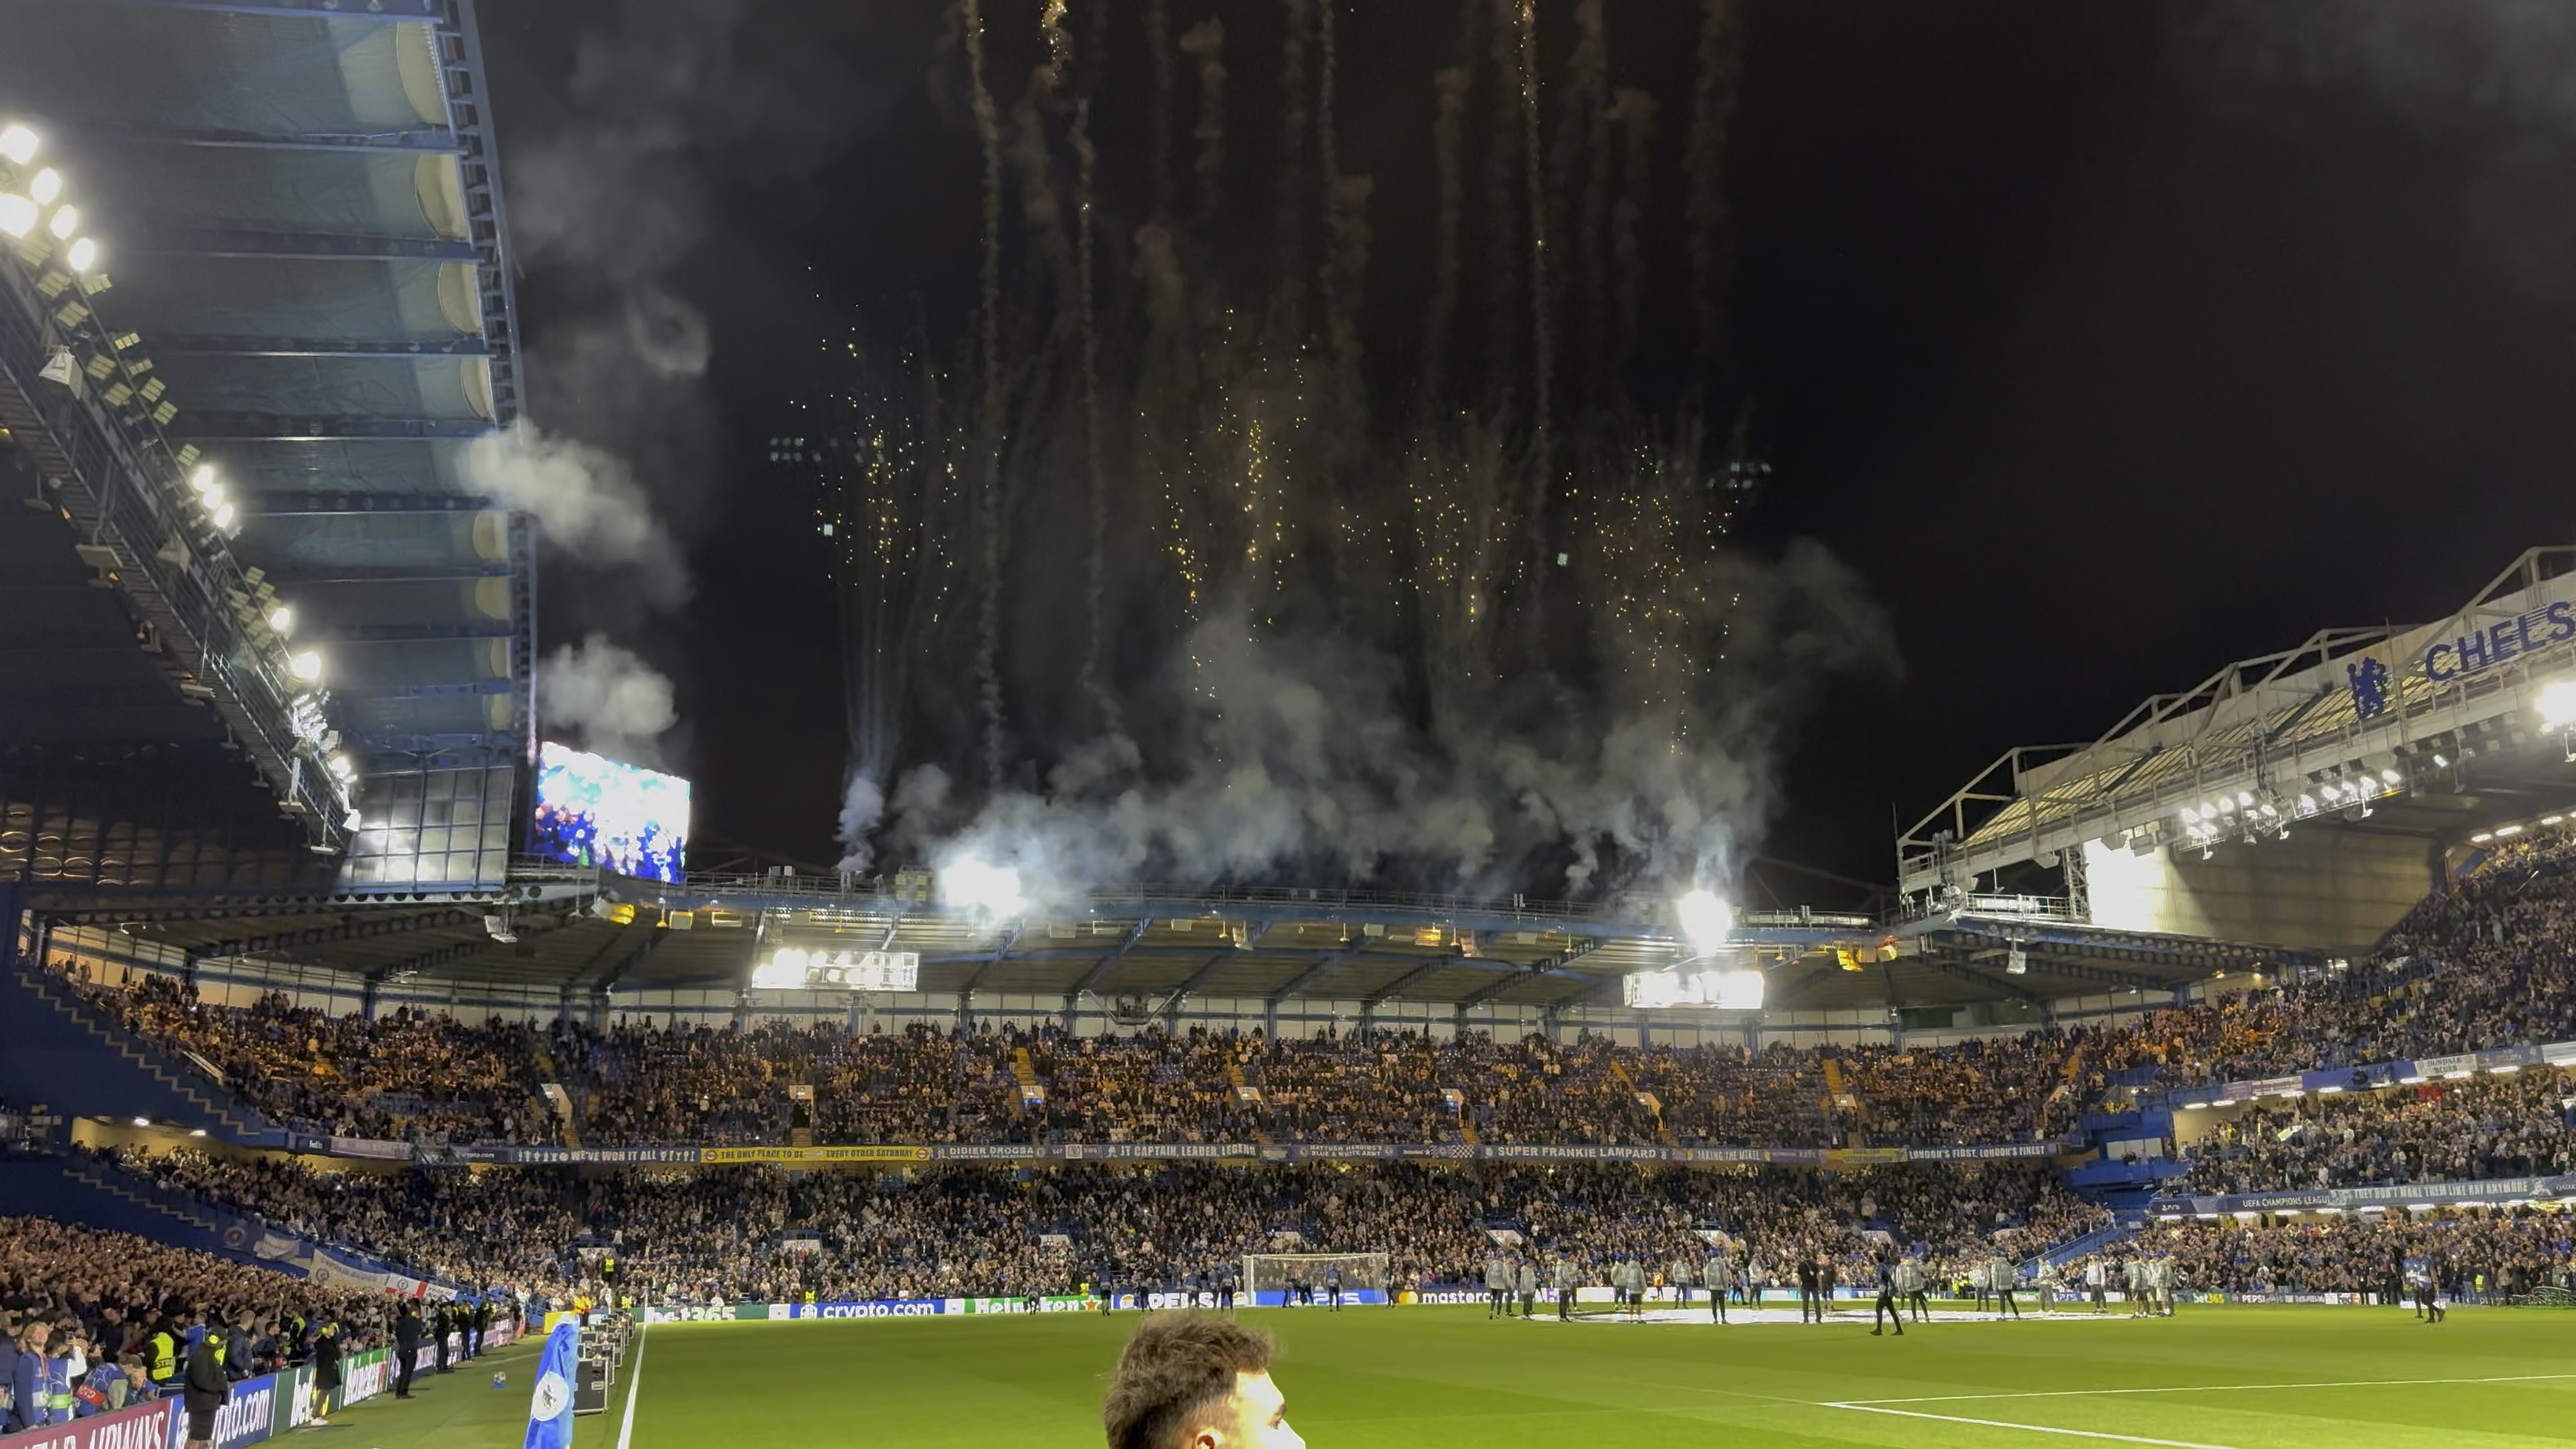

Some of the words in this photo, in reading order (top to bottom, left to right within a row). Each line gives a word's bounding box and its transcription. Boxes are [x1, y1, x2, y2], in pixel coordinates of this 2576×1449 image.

[2425, 601, 2576, 682] CHELS
[570, 1150, 600, 1161] WE'VE
[602, 1150, 625, 1161] WON
[627, 1150, 638, 1161] IT
[640, 1150, 657, 1161] ALL
[721, 1151, 735, 1159] THE
[737, 1150, 755, 1159] ONLY
[757, 1149, 780, 1158] PLACE
[782, 1150, 792, 1158] TO
[794, 1150, 804, 1159] BE
[826, 1149, 848, 1158] EVERY
[851, 1149, 874, 1157] OTHER
[950, 1146, 986, 1155] DIDIER
[989, 1146, 1034, 1155] DROGBA
[1120, 1146, 1131, 1157] JT
[1497, 1146, 1538, 1156] SUPER
[1542, 1147, 1596, 1158] FRANKIE
[1599, 1148, 1657, 1159] LAMPARD
[1697, 1150, 1723, 1161] TAKING
[1725, 1150, 1738, 1161] THE
[1909, 1149, 1950, 1160] LONDON'S
[1979, 1147, 2017, 1158] LONDON'S
[2019, 1146, 2045, 1156] FINEST
[2425, 1184, 2447, 1197] THEM
[2449, 1184, 2467, 1196] LIKE
[2243, 1199, 2261, 1208] UEFA
[2261, 1197, 2302, 1208] CHAMPIONS
[823, 1302, 934, 1318] crypto.com
[975, 1297, 1079, 1314] Heinken
[647, 1307, 736, 1322] bet365
